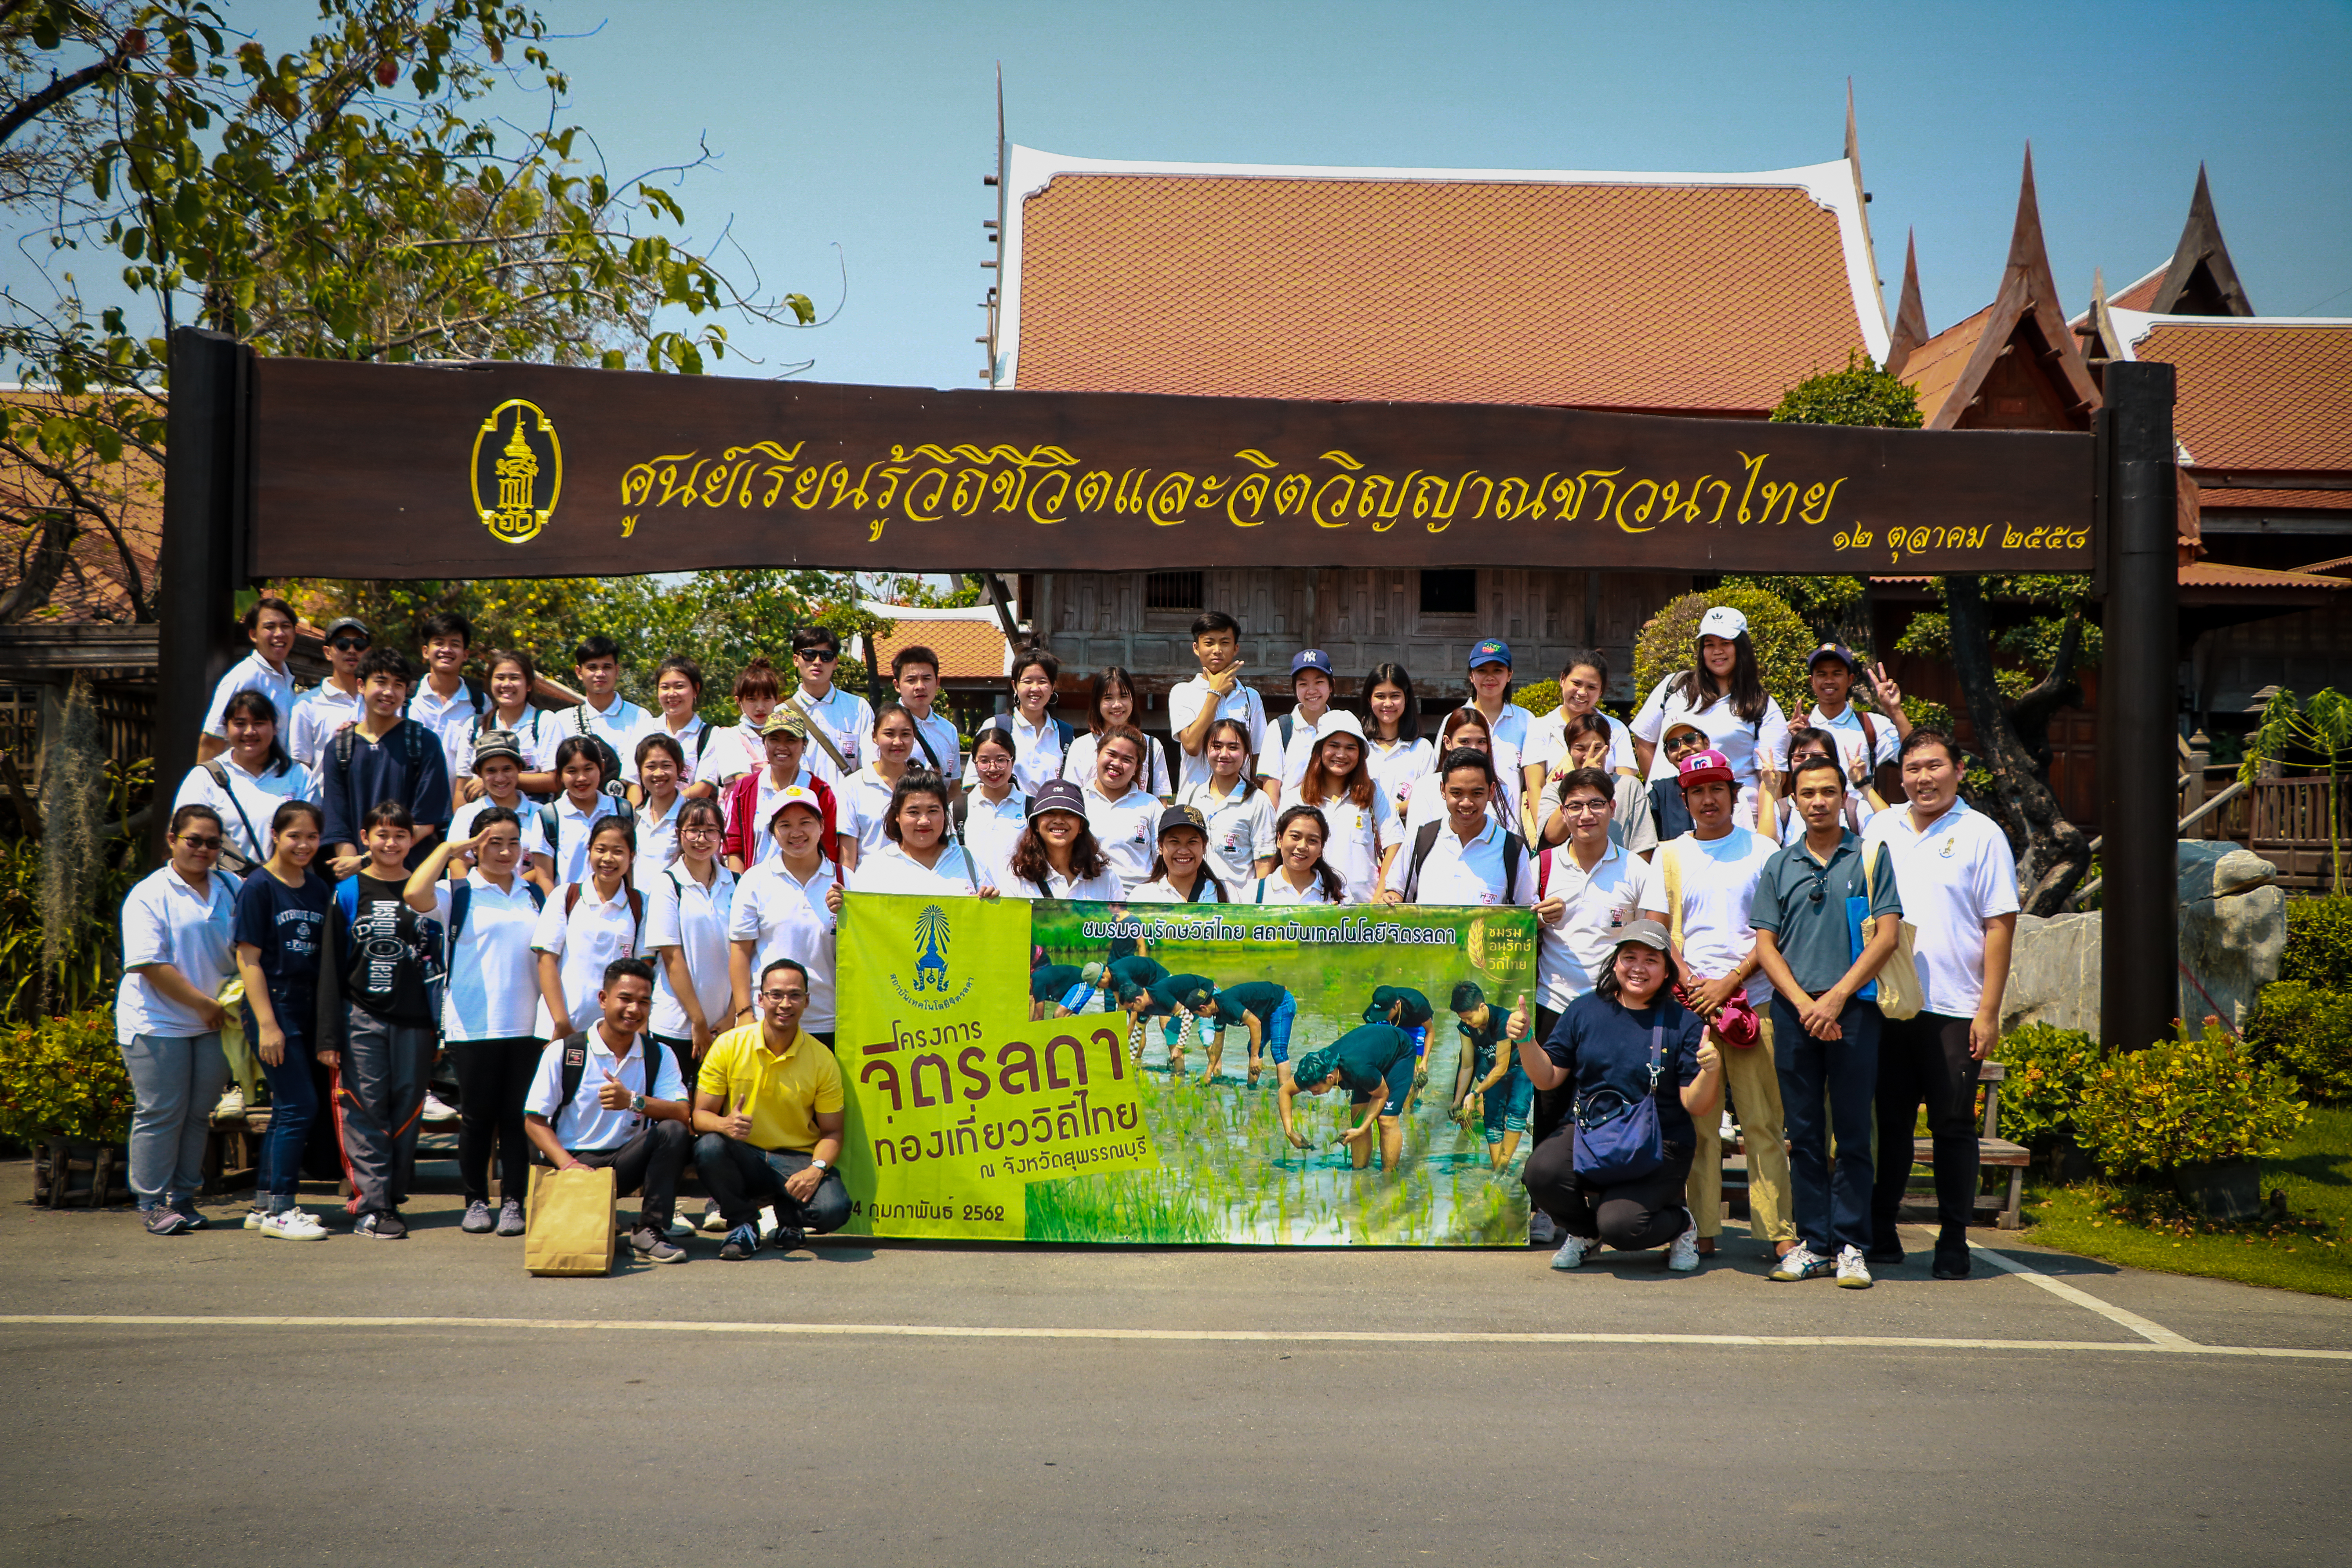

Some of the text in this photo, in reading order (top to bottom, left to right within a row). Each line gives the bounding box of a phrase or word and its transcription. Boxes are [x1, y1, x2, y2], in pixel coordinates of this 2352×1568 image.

[1832, 521, 2091, 564] ๑๒ ตุลาคม ๒๕๕๘
[371, 900, 401, 935] Design
[1083, 915, 1456, 945] ชมรมอนุรักษ์วิถีไทย สถาบันเทคโนโลยีจิตรลดา
[1489, 928, 1522, 938] ชมรม
[1489, 938, 1532, 956] อนุรักษ์
[1489, 955, 1527, 970] วิถีไทย
[890, 973, 975, 1011] สถาบันเทคโนโลยีจิตรลดา
[893, 1020, 983, 1051] โครงการ
[860, 1027, 1124, 1111] จิตรลดา
[875, 1089, 1138, 1167] ท่องเที่ยววิถีไทย
[980, 1135, 1147, 1179] ณ จังหวัดสุพรรณบุรี
[848, 1195, 1005, 1223] 4 กุมภาพันธ์ 2562
